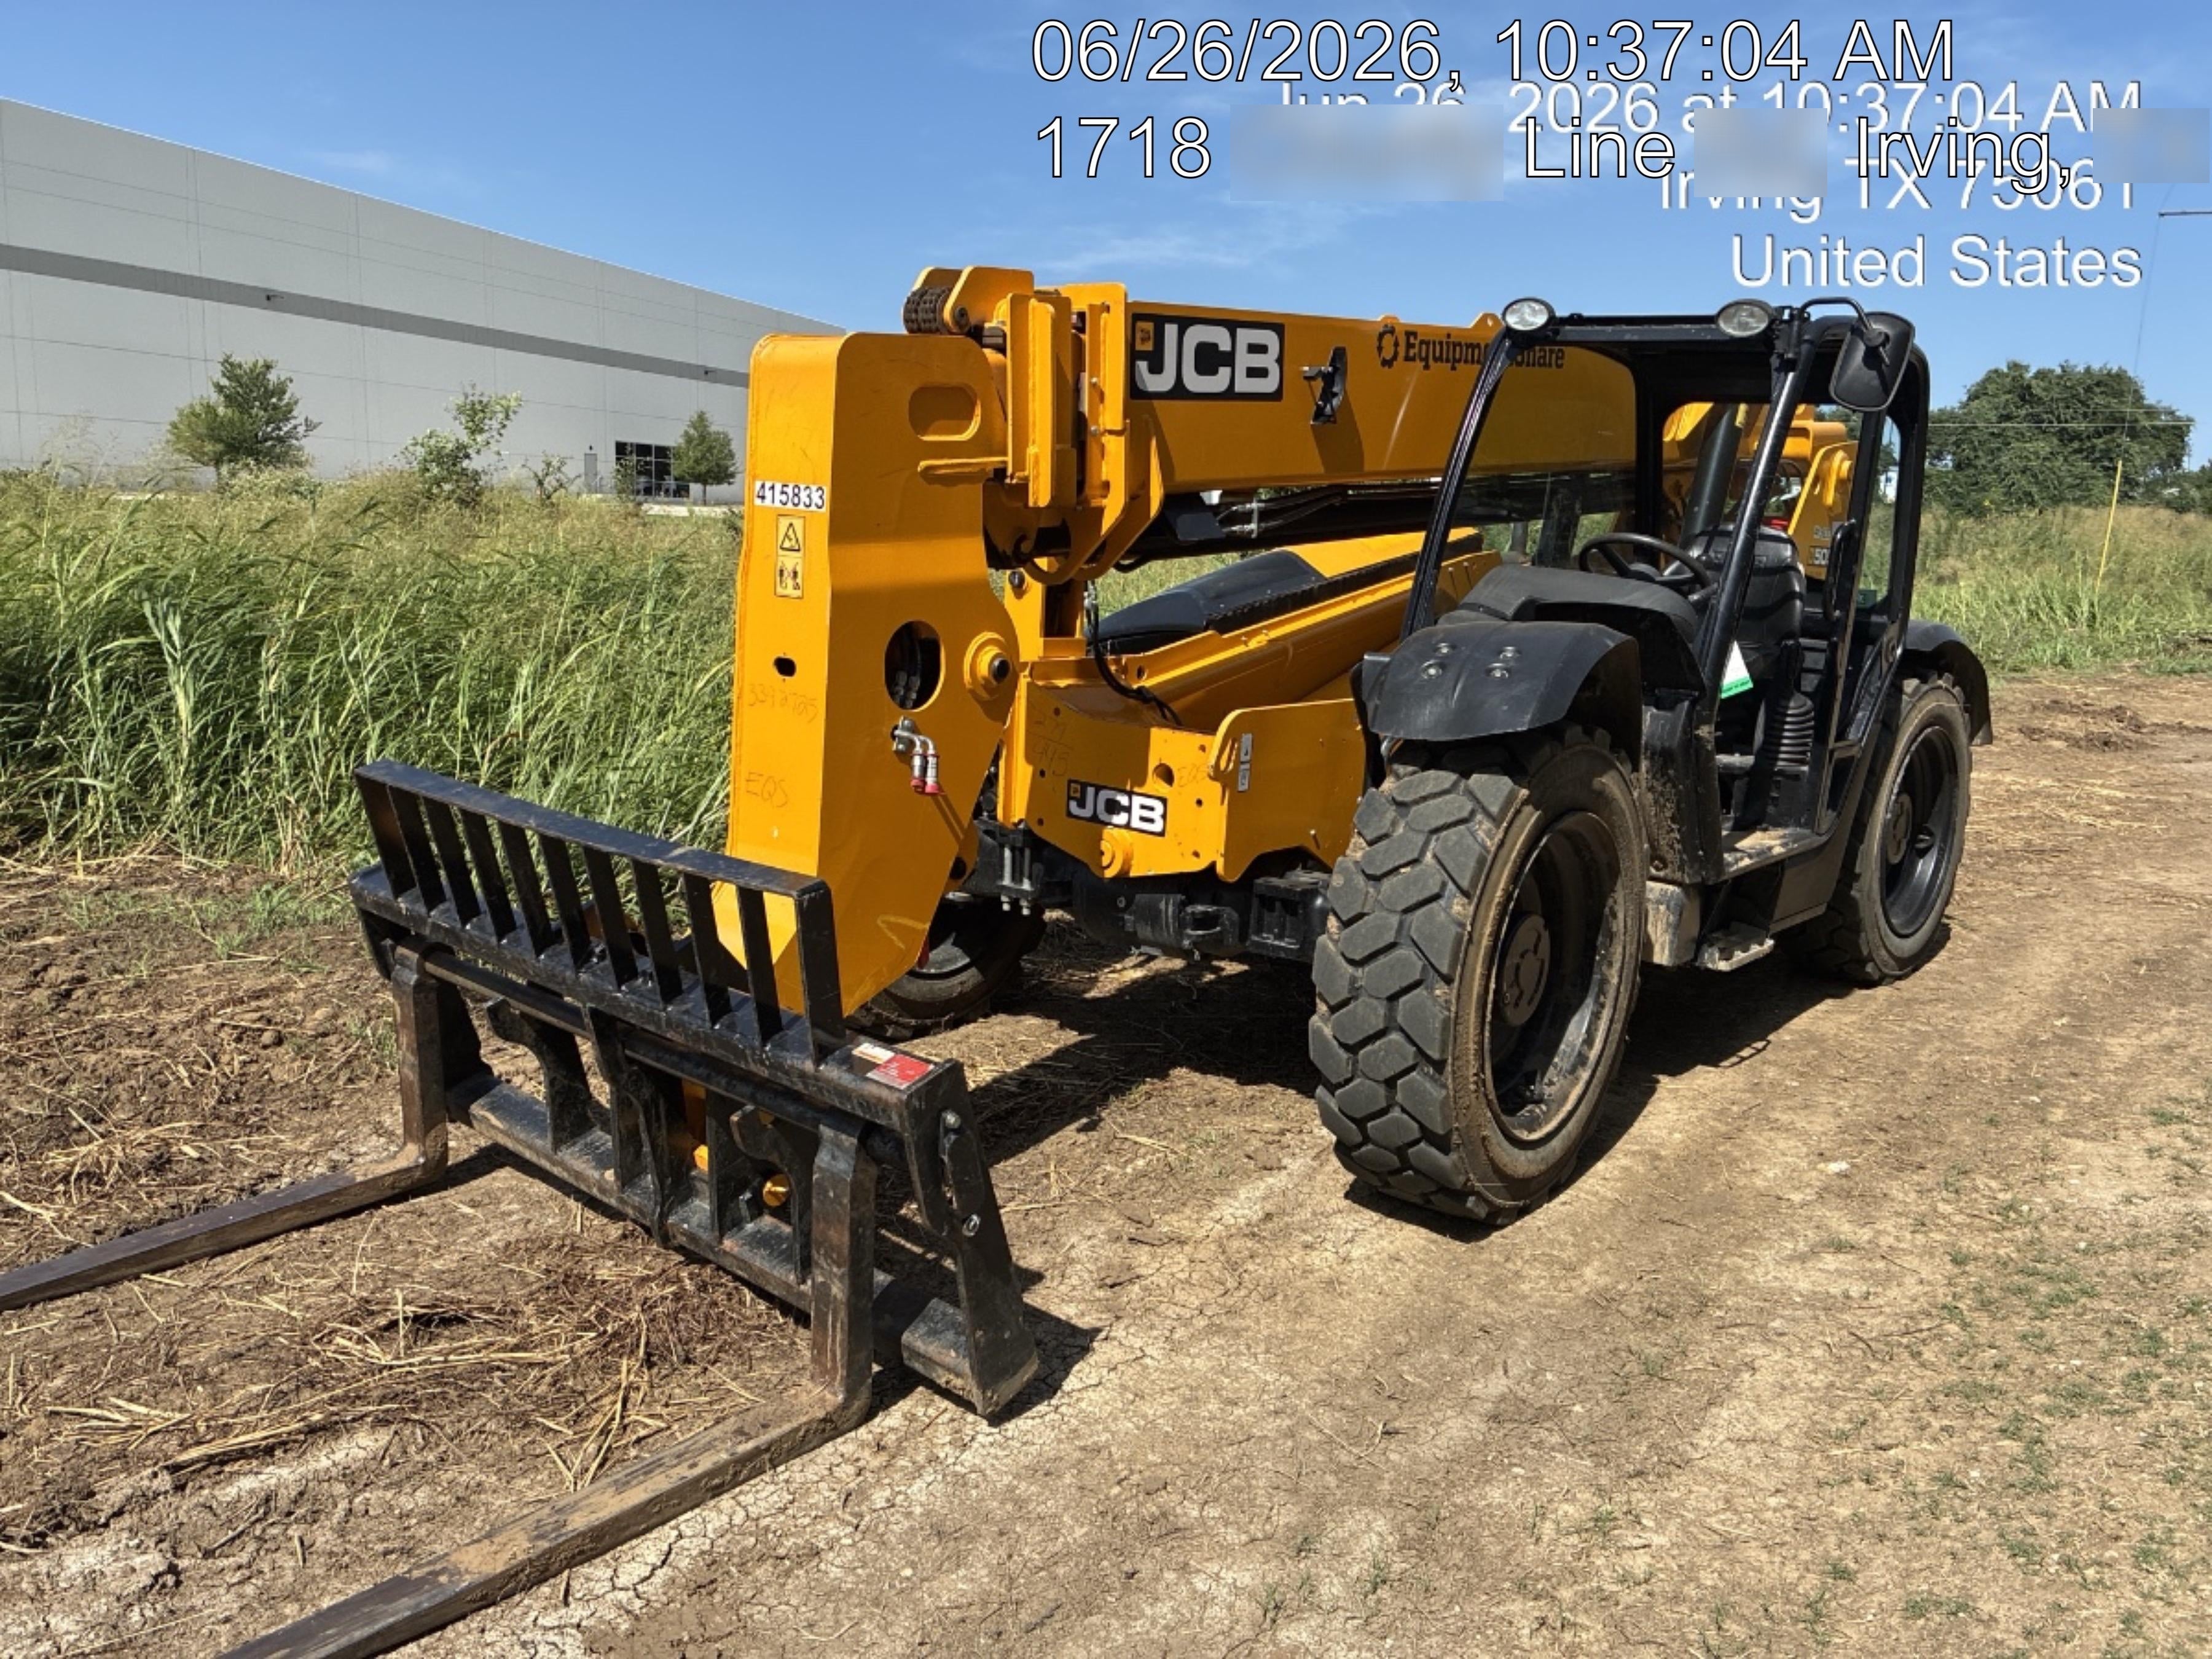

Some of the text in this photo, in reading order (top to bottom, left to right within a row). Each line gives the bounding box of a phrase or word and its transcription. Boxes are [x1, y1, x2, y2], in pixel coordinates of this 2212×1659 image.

[1135, 322, 1281, 394] JCB
[756, 482, 825, 509] 415833
[1068, 786, 1165, 833] JCB
